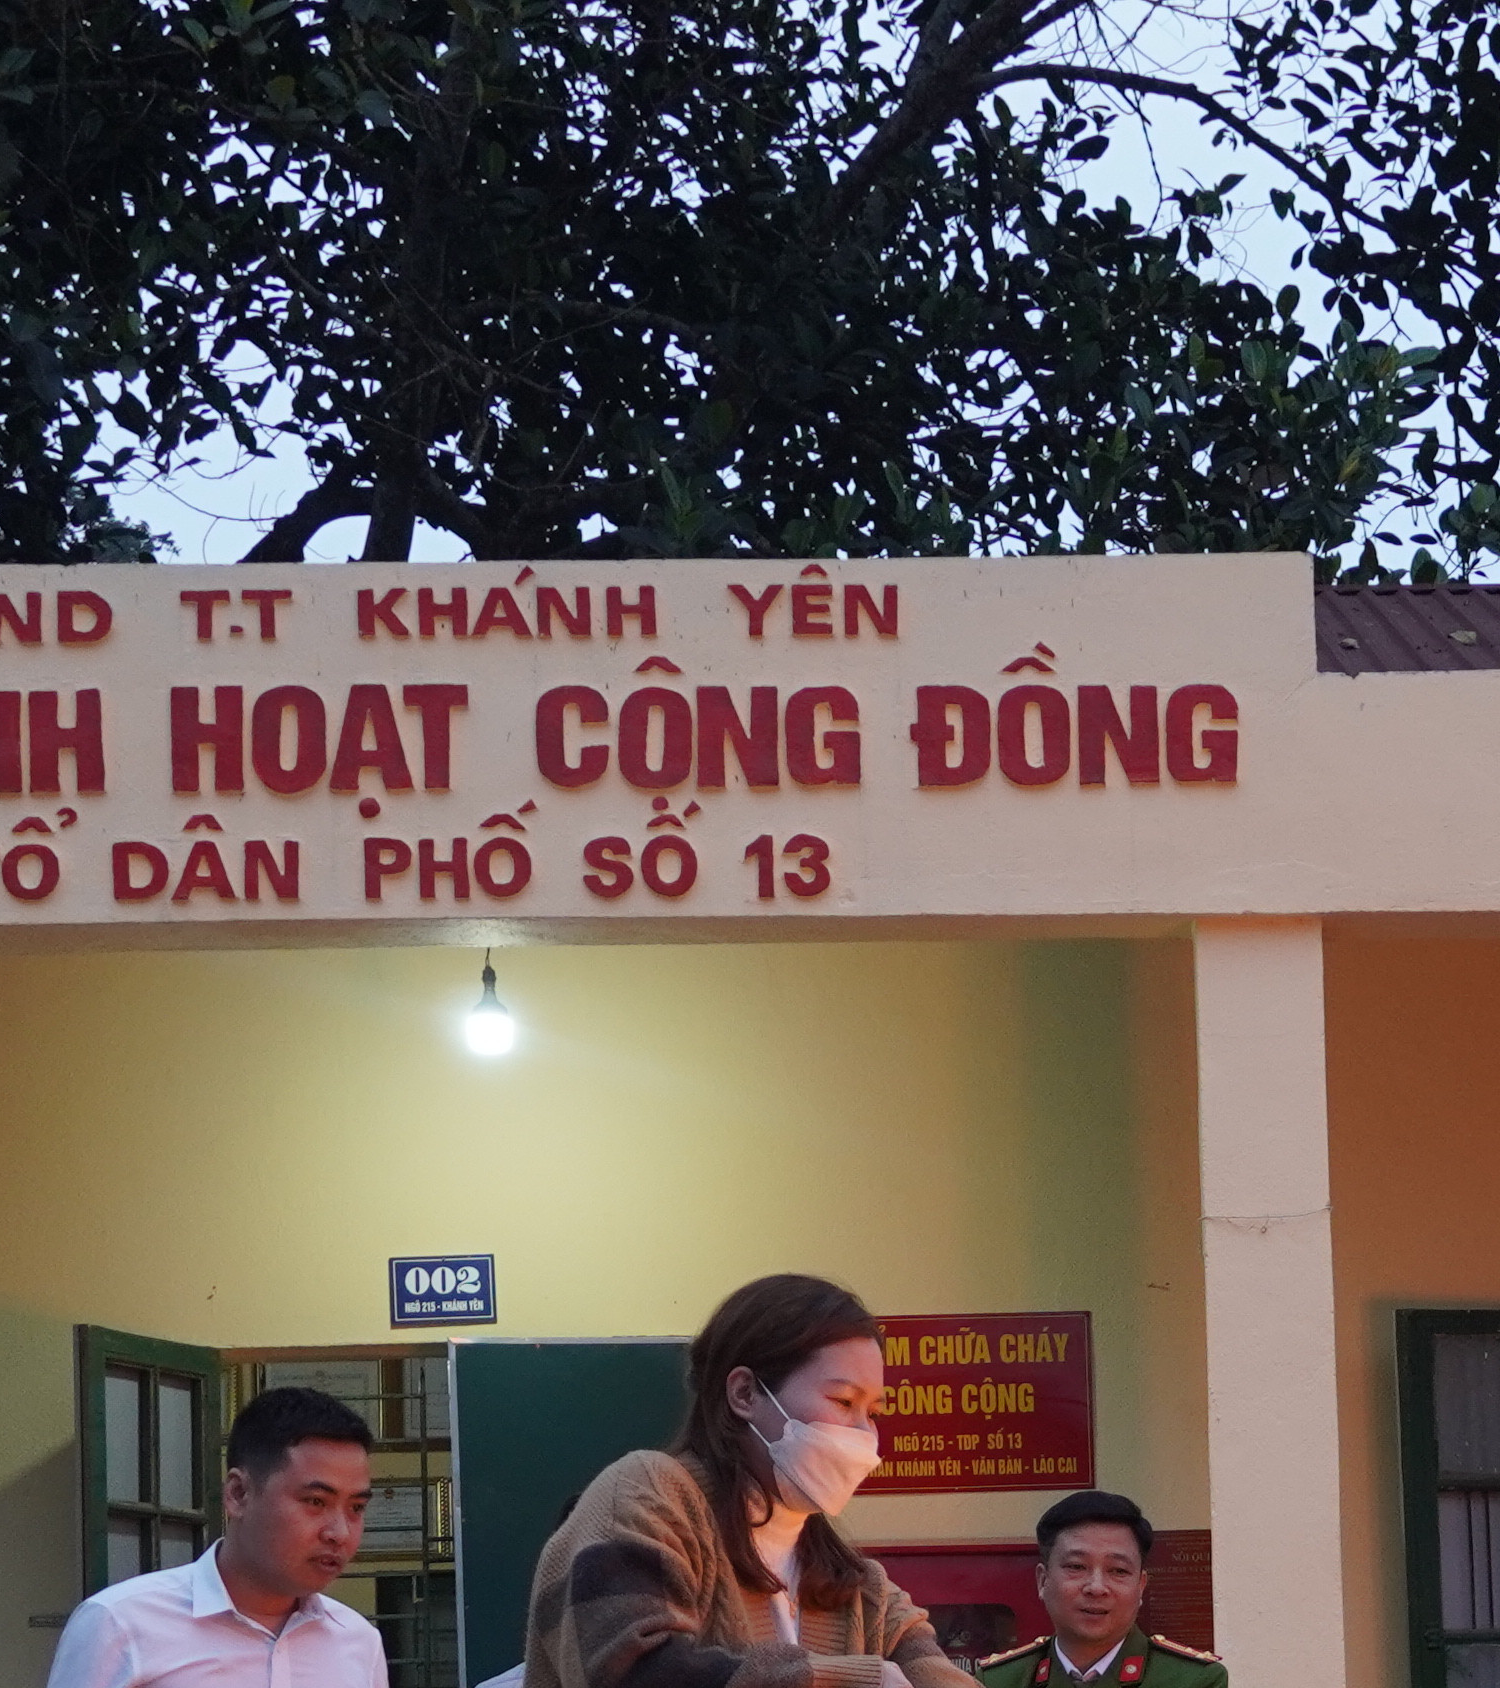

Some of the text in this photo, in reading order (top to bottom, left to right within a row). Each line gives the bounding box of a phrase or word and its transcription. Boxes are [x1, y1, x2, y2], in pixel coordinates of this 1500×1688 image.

[180, 589, 293, 642] T.T
[357, 566, 658, 640] KHÁNH
[727, 563, 899, 640] YÊN
[170, 684, 469, 819] HOẠT
[536, 656, 862, 811] CỘNG
[910, 642, 1239, 787] ĐỒNG
[112, 814, 300, 902] DÂN
[363, 800, 538, 901] PHỐ
[583, 801, 701, 899] SỐ
[744, 834, 831, 900] 13
[404, 1266, 481, 1295] 002
[421, 1301, 436, 1313] 215
[442, 1298, 468, 1312] KHÁNH
[469, 1298, 484, 1311] YÊN
[919, 1327, 991, 1366] CHỮA
[1000, 1326, 1069, 1363] CHÁY
[882, 1377, 1035, 1420] CÔNG CỘNG
[922, 1434, 945, 1451] 215
[957, 1434, 980, 1450] TDP
[987, 1427, 1004, 1449] SỐ
[1007, 1433, 1022, 1449] 13
[897, 1457, 936, 1477] KHÁNH
[939, 1456, 961, 1475] YÊN
[1057, 1457, 1077, 1473] CAI
